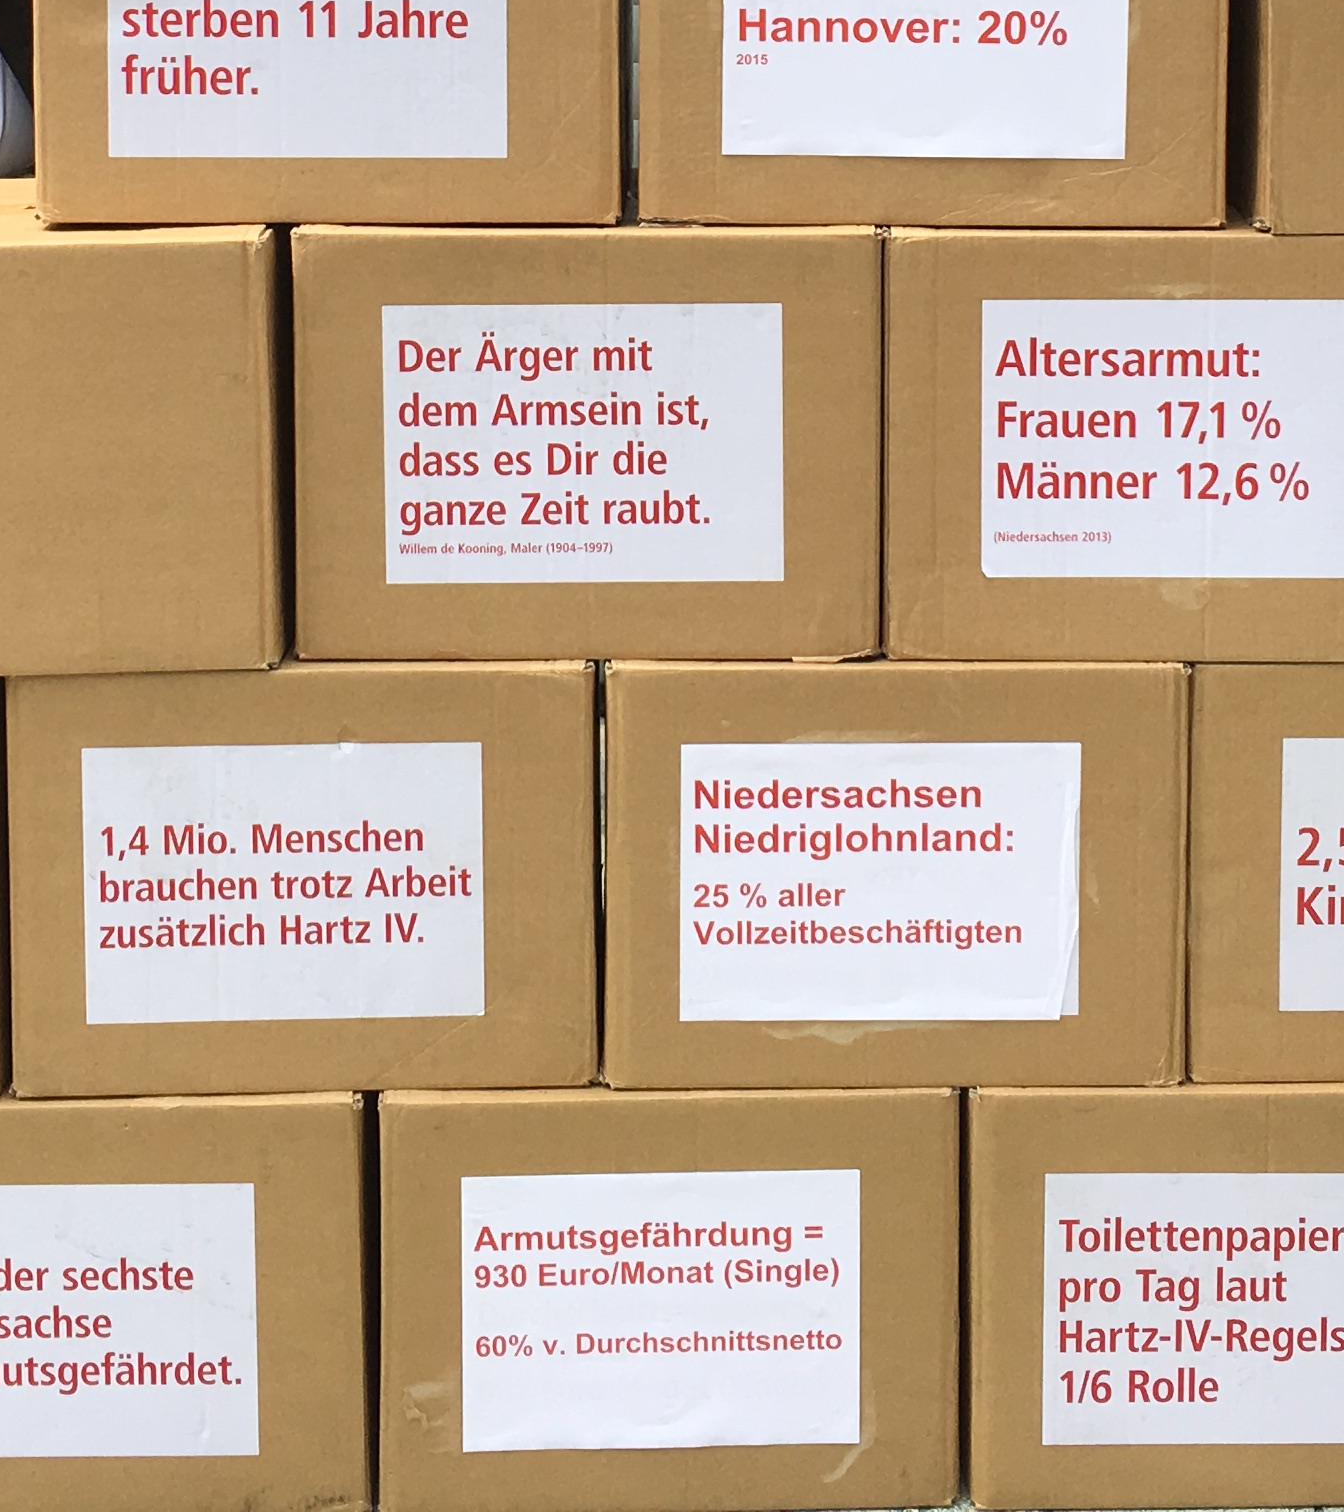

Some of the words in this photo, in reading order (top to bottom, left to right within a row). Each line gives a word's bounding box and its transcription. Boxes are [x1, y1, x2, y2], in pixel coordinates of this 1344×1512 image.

[299, 0, 336, 38] 11
[738, 8, 961, 44] Hannover:
[977, 9, 1068, 47] 20%
[121, 53, 258, 96] früher.
[735, 53, 769, 65] 2015
[397, 338, 462, 374] Der
[474, 331, 580, 383] Ärger
[591, 336, 653, 373] mit
[994, 336, 1261, 379] Altersarmut:
[397, 391, 478, 429] dem
[490, 391, 642, 427] Armsein
[656, 391, 709, 431] ist,
[995, 399, 1138, 440] Frauen
[1156, 400, 1226, 445] 17,1
[1240, 399, 1283, 441] %
[398, 441, 480, 478] dass
[492, 450, 533, 477] es
[546, 440, 599, 477] Dir
[611, 440, 669, 477] die
[995, 460, 1159, 501] Männer
[1176, 461, 1260, 507] 12,6
[1268, 461, 1310, 502] %
[399, 500, 507, 537] ganze
[520, 490, 590, 527] Zeit
[602, 489, 711, 526] raubt.
[398, 542, 438, 555] Willem
[440, 542, 455, 554] de
[457, 542, 507, 557] Kooning,
[510, 542, 543, 554] Maler
[545, 542, 613, 556] (1904–1997)
[993, 531, 1078, 544] (Niedersachsen
[1081, 531, 1112, 544] 2013)
[693, 778, 982, 810] Niedersachsen
[101, 825, 149, 860] 1,4
[163, 823, 236, 855] Mio.
[251, 819, 424, 854] Menschen
[694, 822, 1014, 862] Niedriglohnland:
[99, 868, 258, 903] brauchen
[271, 871, 352, 900] trotz
[365, 865, 471, 898] Arbeit
[693, 883, 730, 909] 25
[739, 882, 767, 908] %
[777, 882, 846, 908] aller
[99, 913, 266, 949] zusätzlich
[279, 914, 371, 945] Hartz
[384, 912, 424, 943] IV.
[693, 919, 1023, 951] Vollzeitbeschäftigten
[473, 1220, 793, 1257] Armutsgefährdung
[803, 1225, 824, 1240] =
[1058, 1216, 1344, 1262] Toilettenpapier
[62, 1257, 194, 1291] sechste
[473, 1263, 528, 1289] 930
[538, 1260, 714, 1288] Euro/Monat
[723, 1257, 840, 1289] (Single)
[1058, 1276, 1122, 1313] pro
[1135, 1268, 1200, 1313] Tag
[1215, 1266, 1287, 1303] laut
[475, 1334, 534, 1358] 60%
[542, 1339, 566, 1356] v.
[575, 1329, 843, 1355] Durchschnittsnetto
[1060, 1369, 1113, 1404] 1/6
[1127, 1367, 1219, 1404] Rolle
